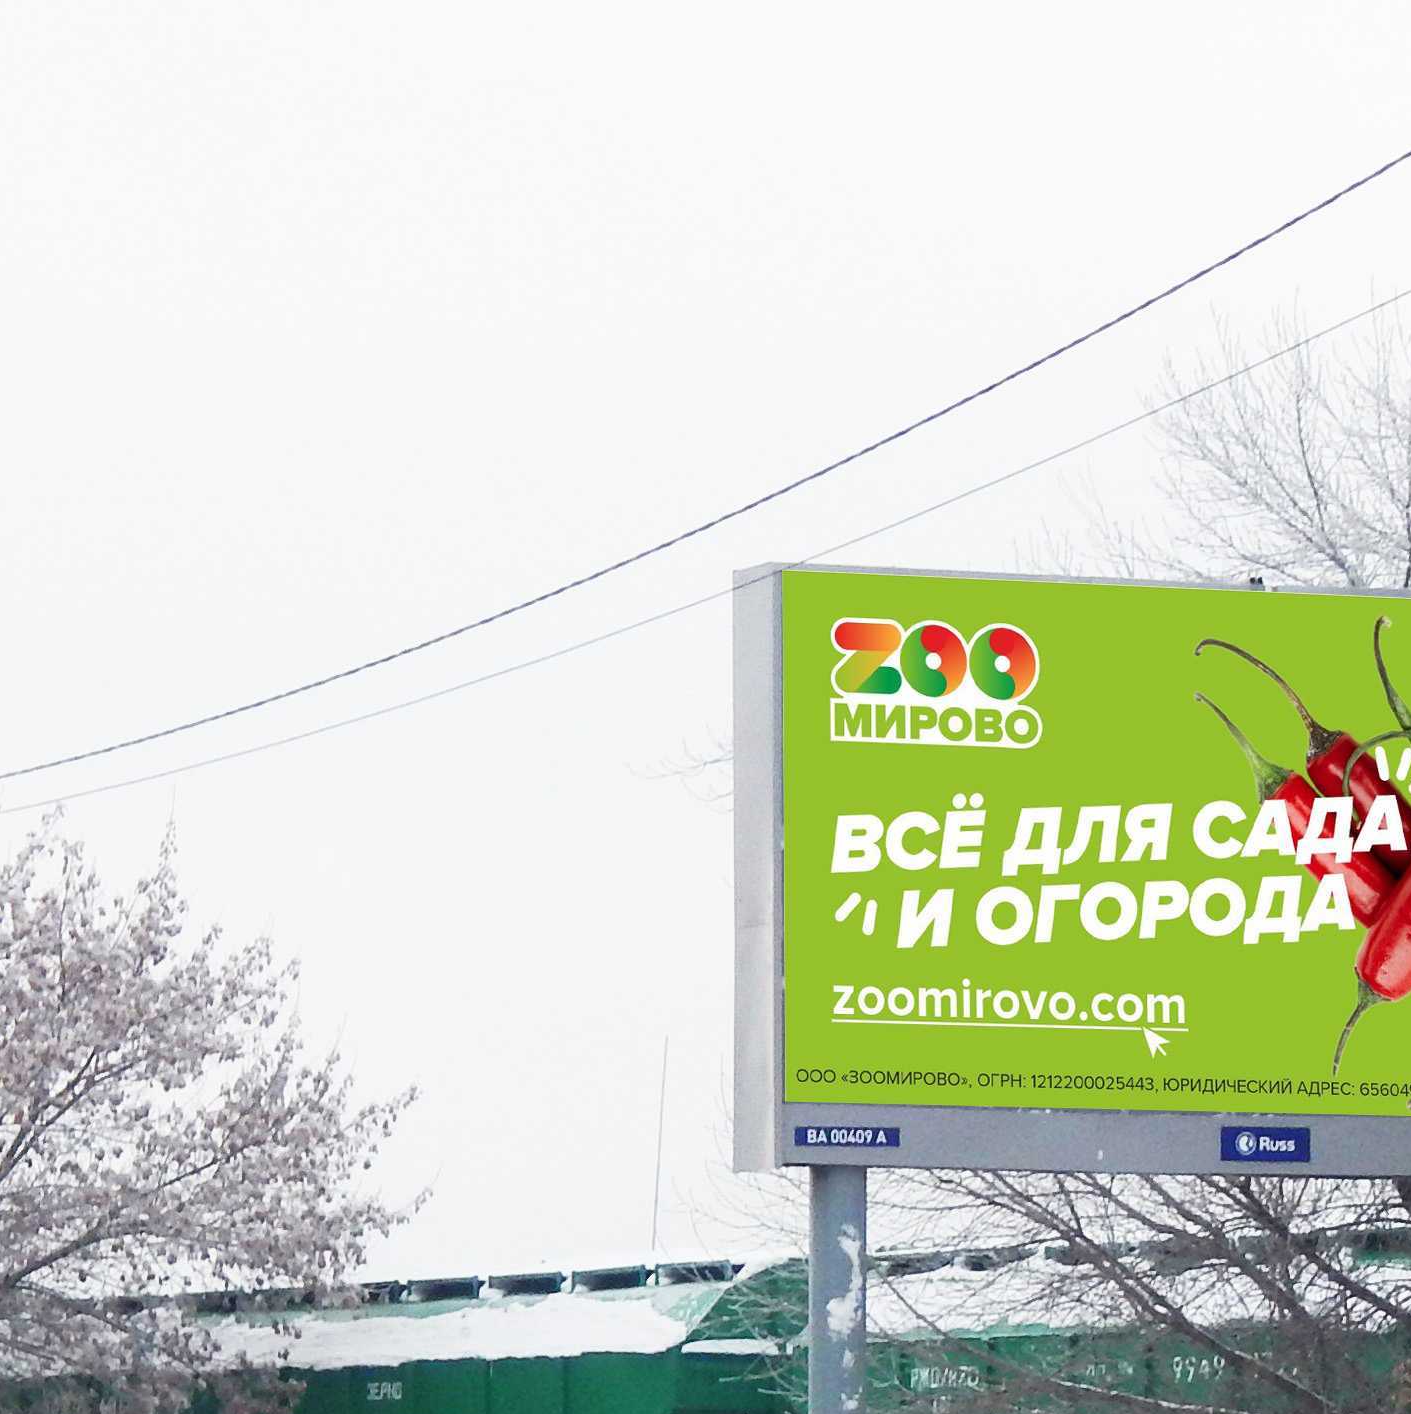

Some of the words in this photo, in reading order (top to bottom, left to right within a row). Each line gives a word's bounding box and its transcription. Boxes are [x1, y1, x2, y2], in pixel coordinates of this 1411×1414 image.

[831, 617, 1039, 701] ZOO
[833, 701, 1040, 746] МИРОВО
[830, 792, 987, 874] ВСЁ
[1001, 802, 1173, 877] ДЛЯ
[1191, 794, 1408, 865] САДА
[895, 887, 954, 949] И
[975, 872, 1357, 946] ОГОРОДА
[832, 978, 1187, 1024] zoomirovo.com
[795, 1068, 837, 1084] ООО
[977, 1072, 1027, 1089] ОГРН:
[1031, 1073, 1159, 1094] 1212200025443,
[1163, 1077, 1292, 1096] ЮРИДИЧЕСКИЙ
[1296, 1080, 1355, 1097] АДРЕС:
[1258, 1135, 1296, 1152] Russ
